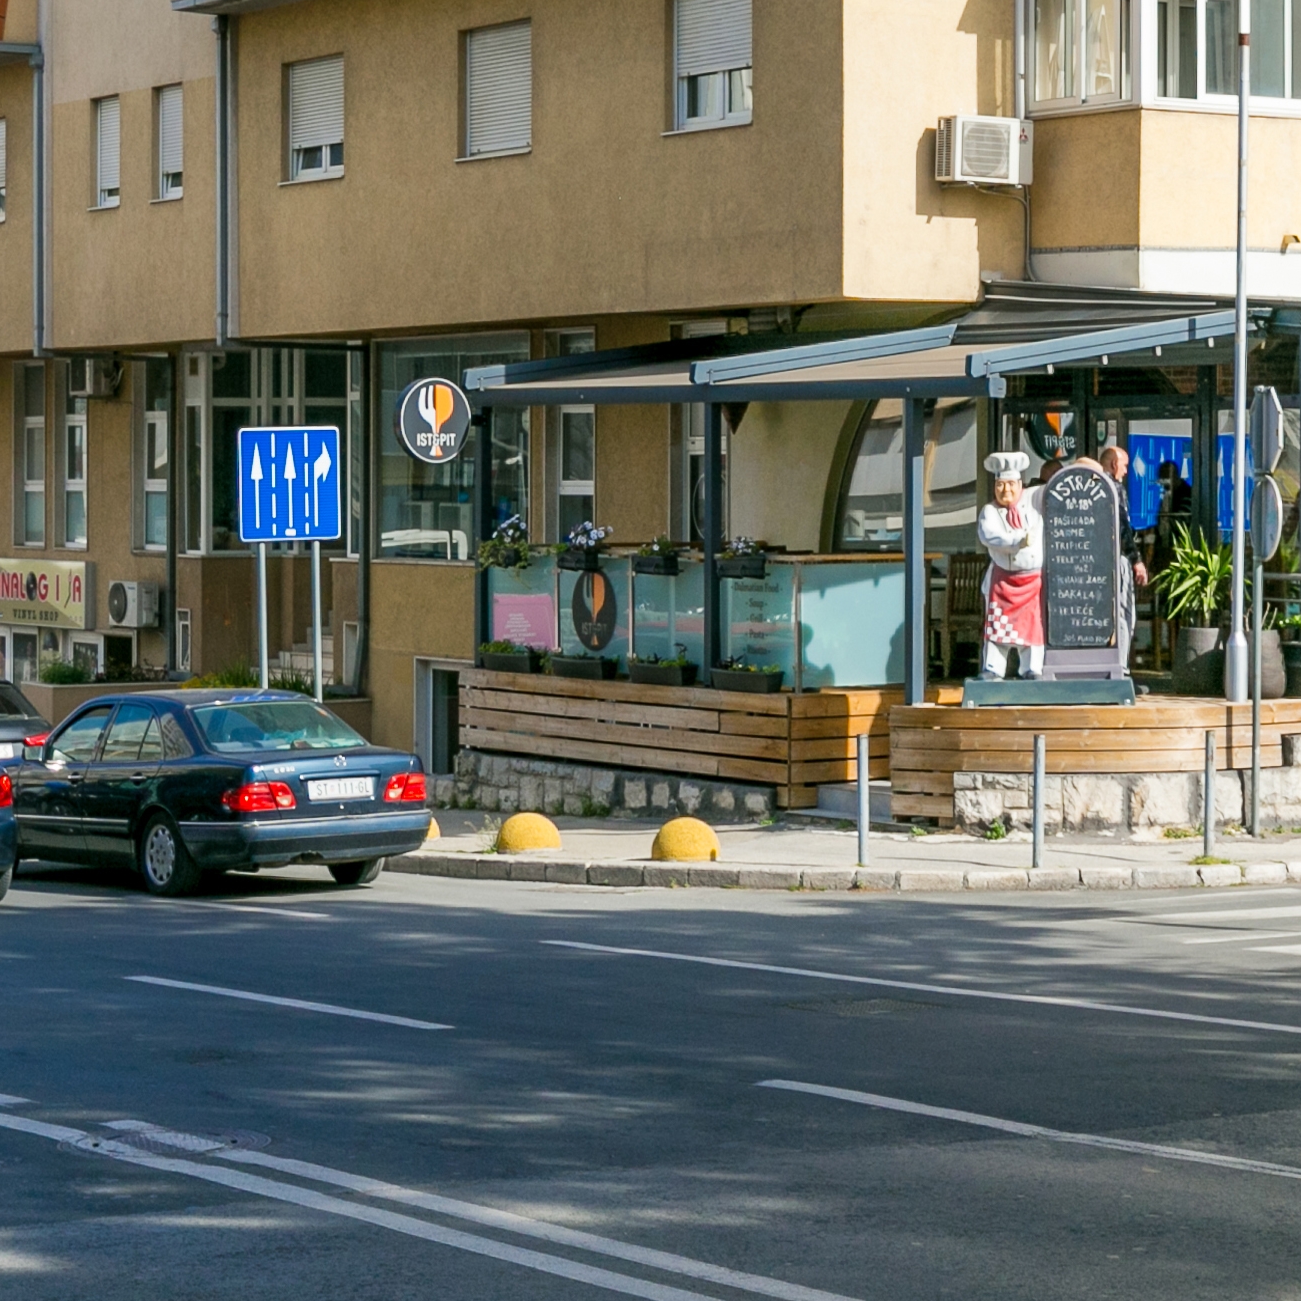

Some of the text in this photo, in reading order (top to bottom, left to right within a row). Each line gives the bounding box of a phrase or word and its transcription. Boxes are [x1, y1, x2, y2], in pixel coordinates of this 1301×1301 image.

[416, 433, 456, 446] IST&PIT
[13, 609, 37, 620] VINYL
[39, 610, 59, 621] SHOP
[317, 781, 370, 796] ST 111-GL
